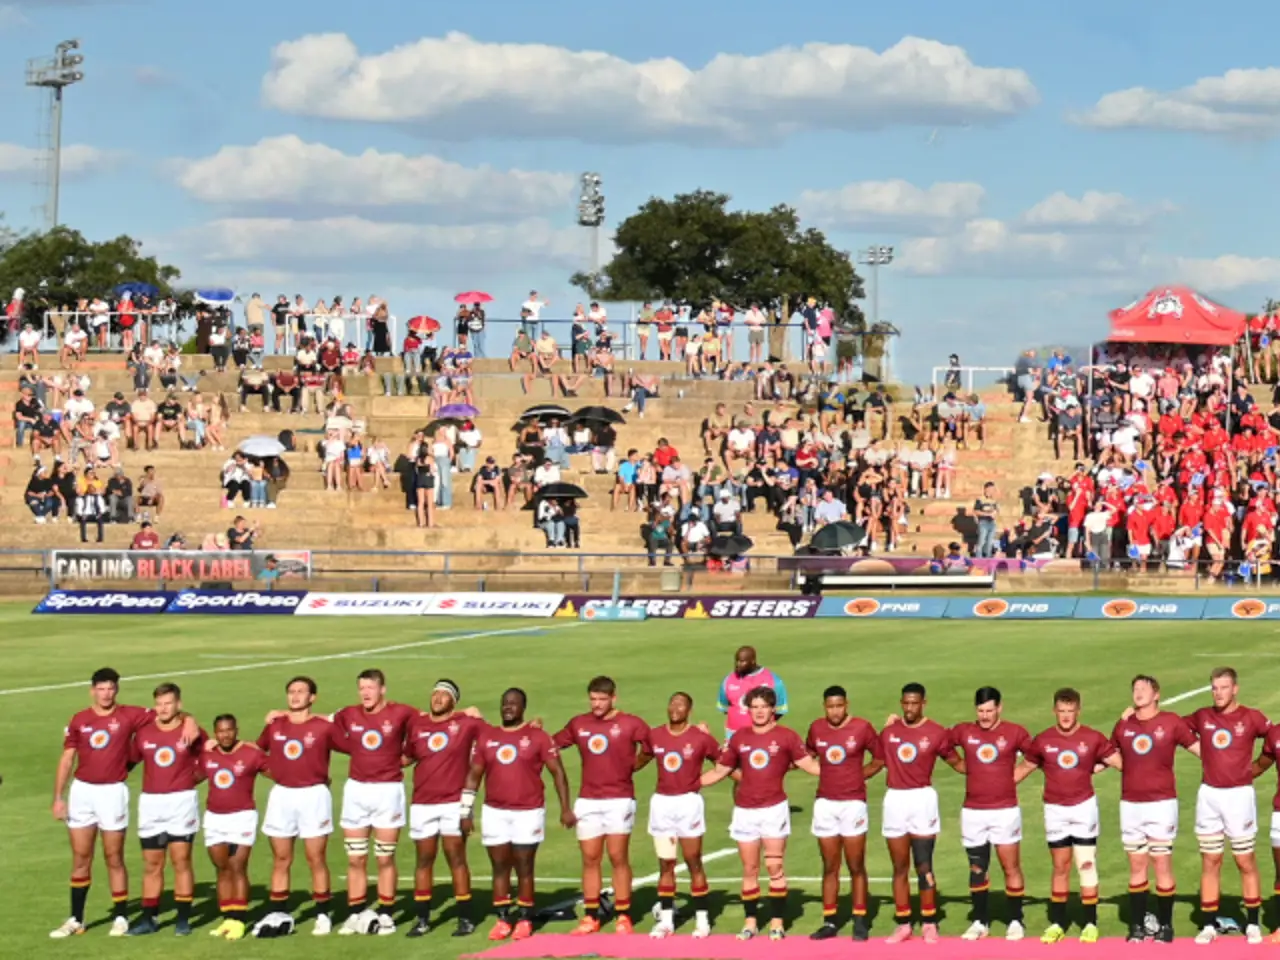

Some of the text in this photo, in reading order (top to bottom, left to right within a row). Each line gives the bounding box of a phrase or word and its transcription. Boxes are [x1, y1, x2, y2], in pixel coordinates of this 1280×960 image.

[57, 558, 252, 581] CARLING BLACK LABEL
[46, 591, 166, 609] SportPesa
[177, 592, 299, 609] SportPesa
[333, 599, 423, 608] SUZUKI
[462, 600, 551, 610] SUZUKI
[710, 600, 811, 617] STEERS
[881, 603, 920, 612] FNB
[1010, 603, 1048, 613] FNB
[1139, 603, 1177, 613] FNB
